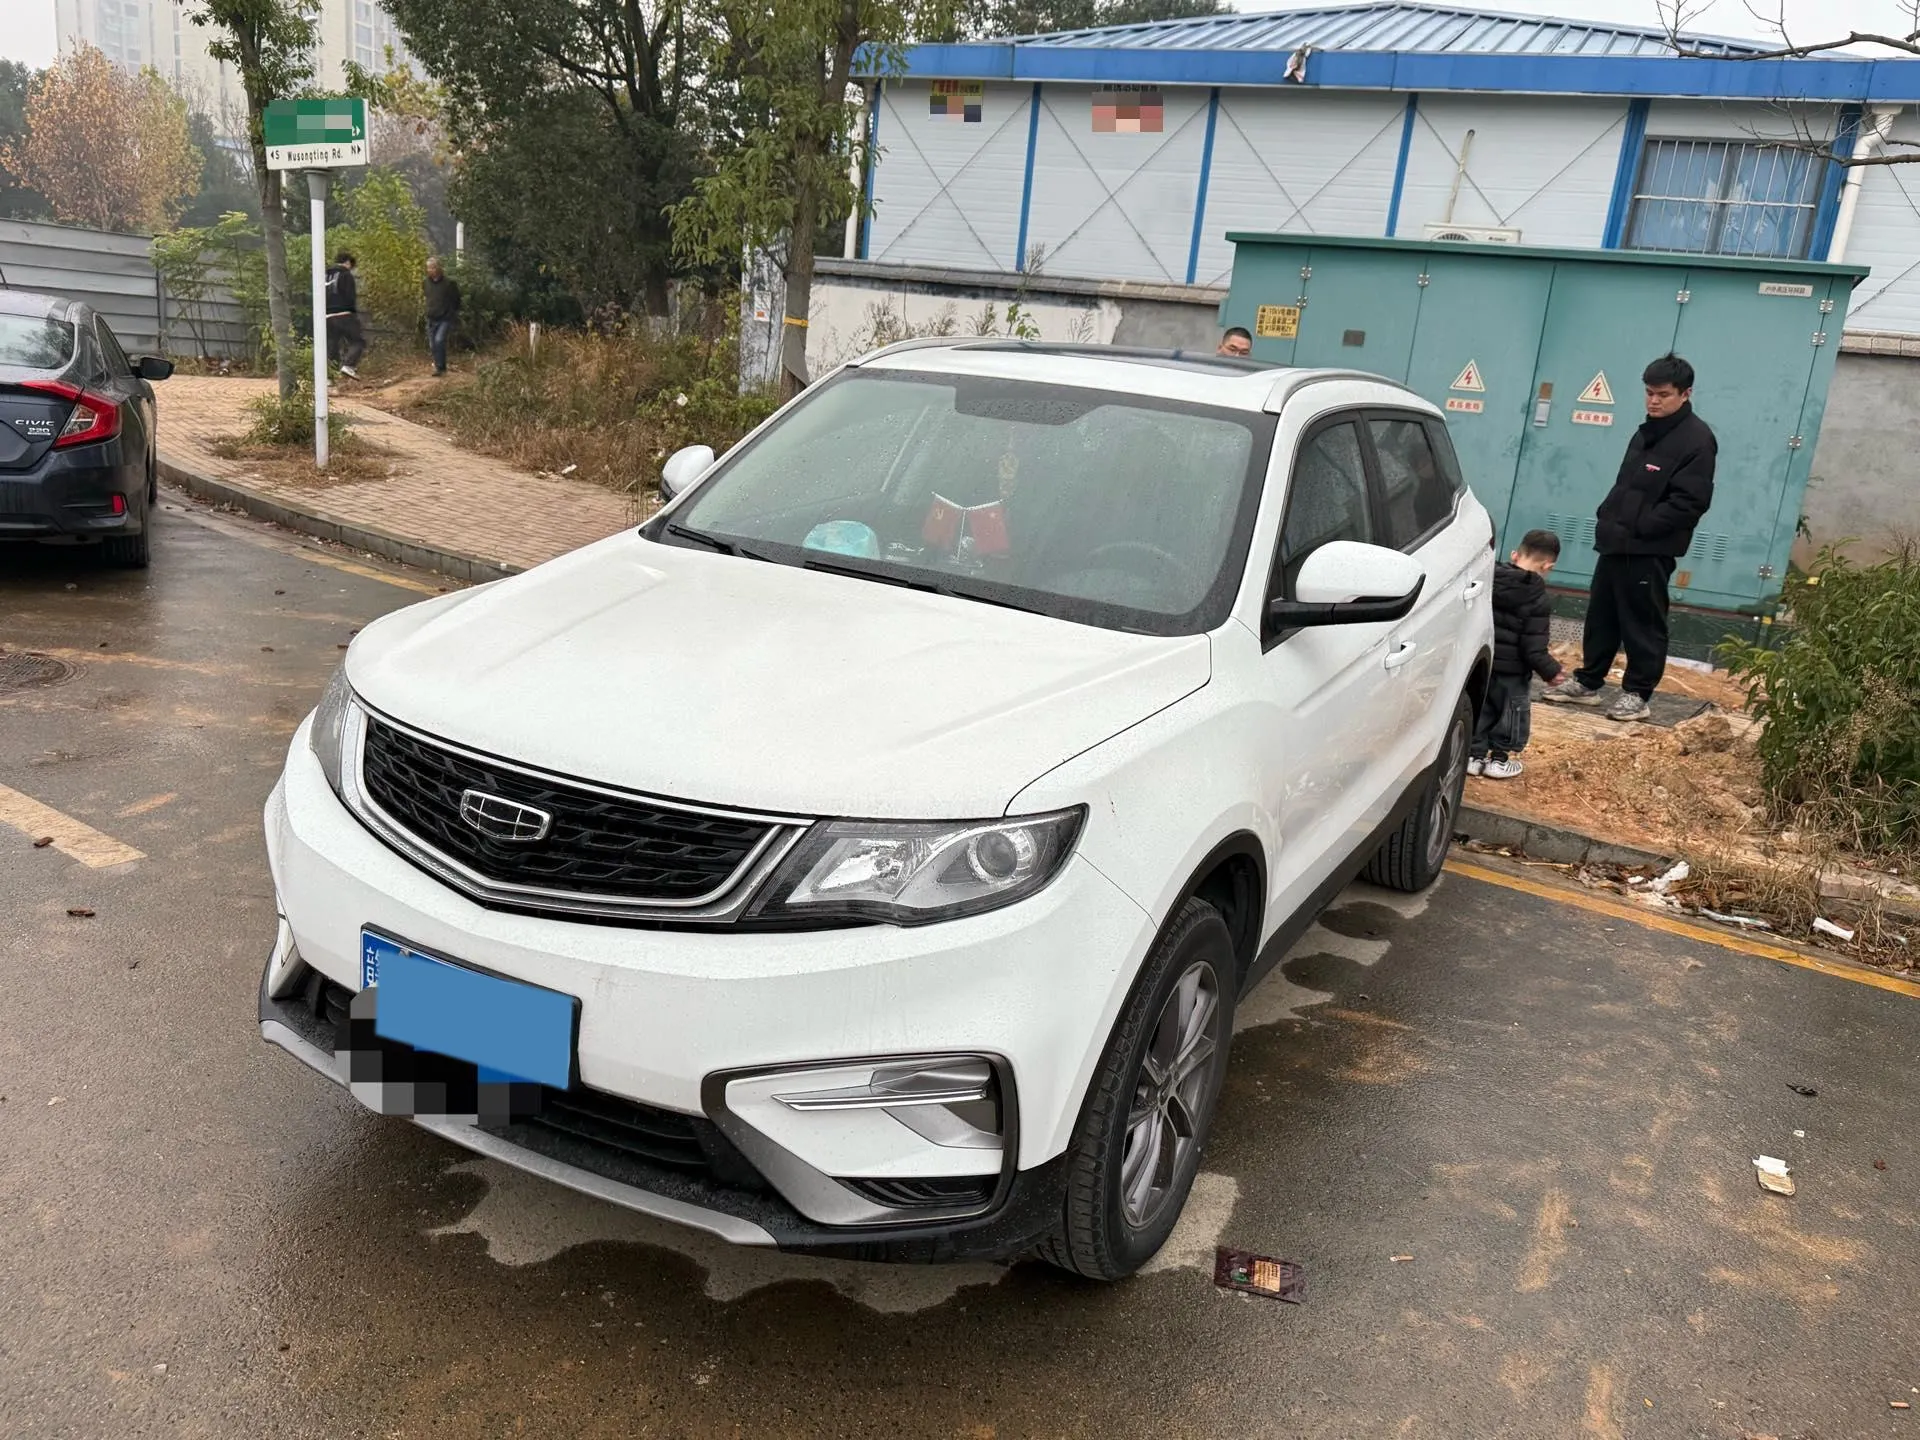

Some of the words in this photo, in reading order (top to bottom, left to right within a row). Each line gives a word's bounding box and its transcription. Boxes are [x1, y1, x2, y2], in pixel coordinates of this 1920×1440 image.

[275, 150, 280, 159] S
[287, 149, 329, 163] Wusongting
[332, 148, 343, 160] Rd.
[351, 145, 357, 154] N
[15, 419, 55, 427] CIVIC
